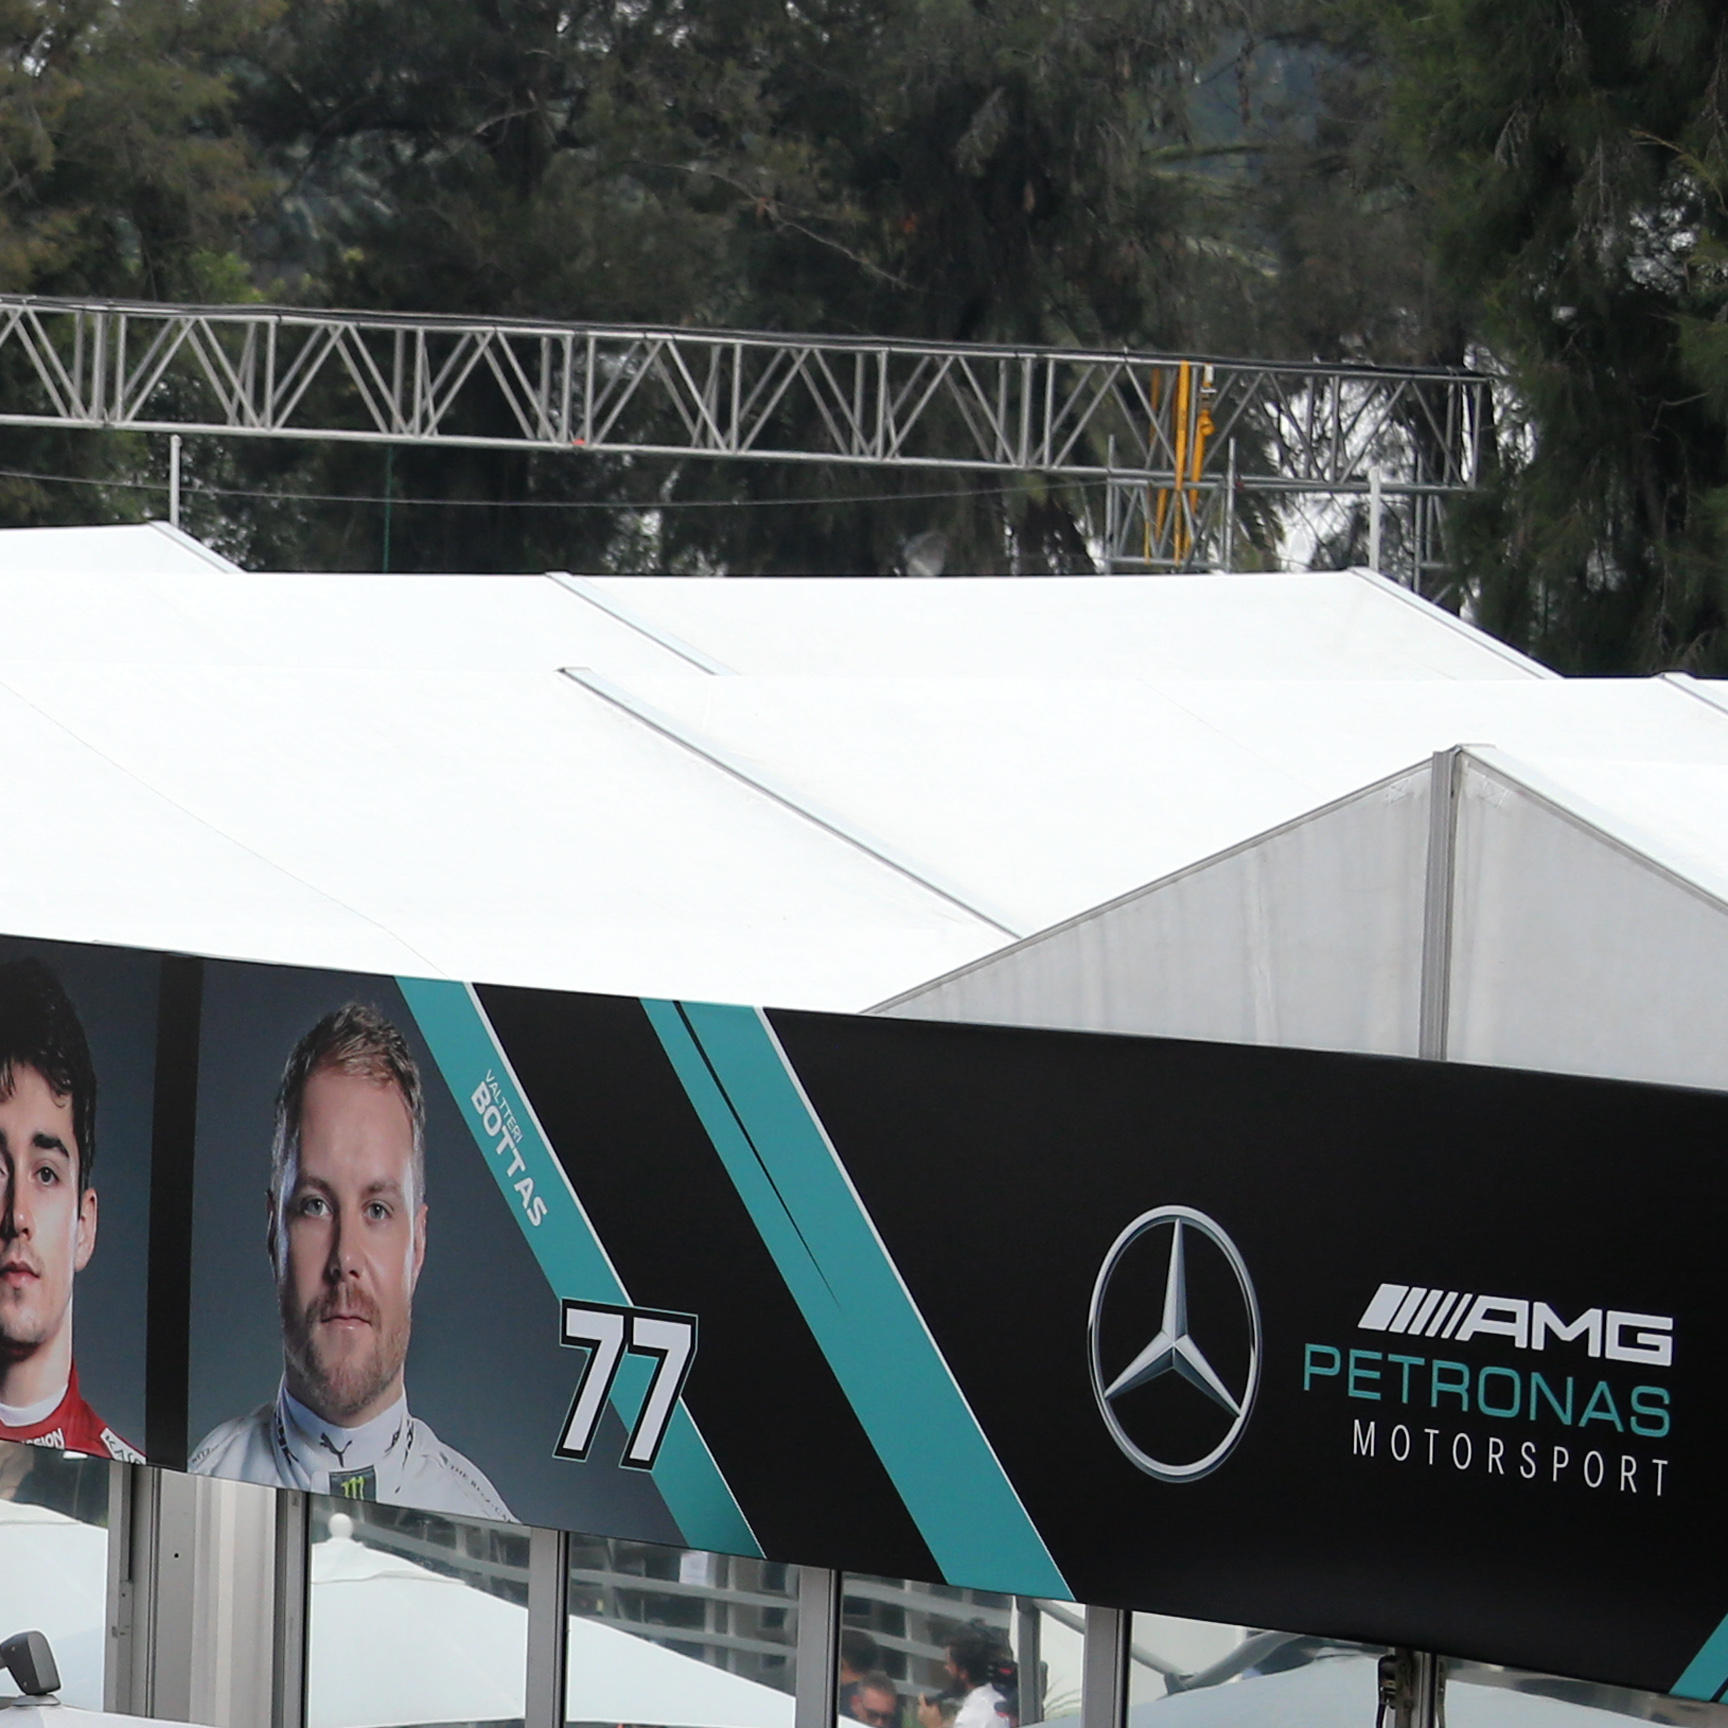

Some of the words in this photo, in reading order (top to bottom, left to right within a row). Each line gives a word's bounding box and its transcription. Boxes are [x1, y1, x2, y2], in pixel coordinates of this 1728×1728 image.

[486, 1068, 524, 1143] VALTTERI
[470, 1080, 548, 1227] BOTTAS
[1456, 1295, 1673, 1366] AMG
[554, 1299, 697, 1469] 77
[1303, 1343, 1671, 1437] PETRONAS
[1352, 1418, 1669, 1496] MOTORSPORT
